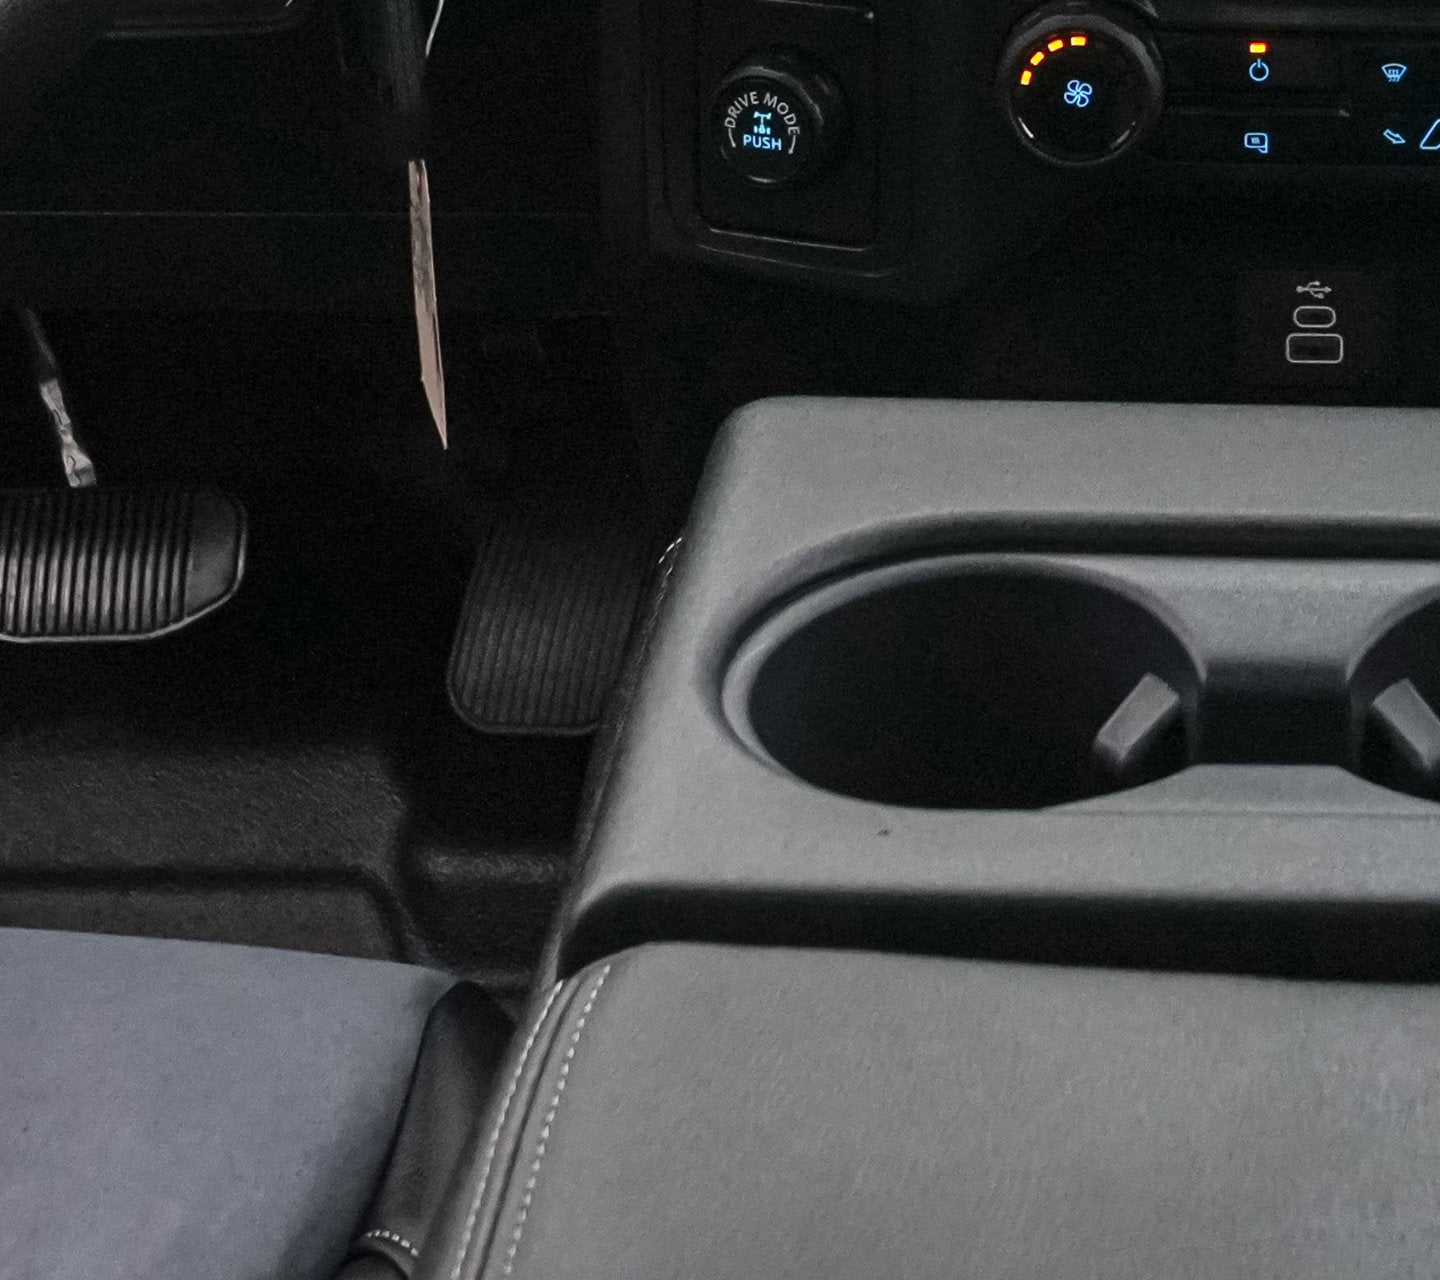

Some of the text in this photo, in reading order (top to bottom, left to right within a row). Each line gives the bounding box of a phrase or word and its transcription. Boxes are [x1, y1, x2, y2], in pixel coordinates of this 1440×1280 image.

[724, 91, 801, 135] DRIVE MODE
[743, 134, 782, 151] PUSH
